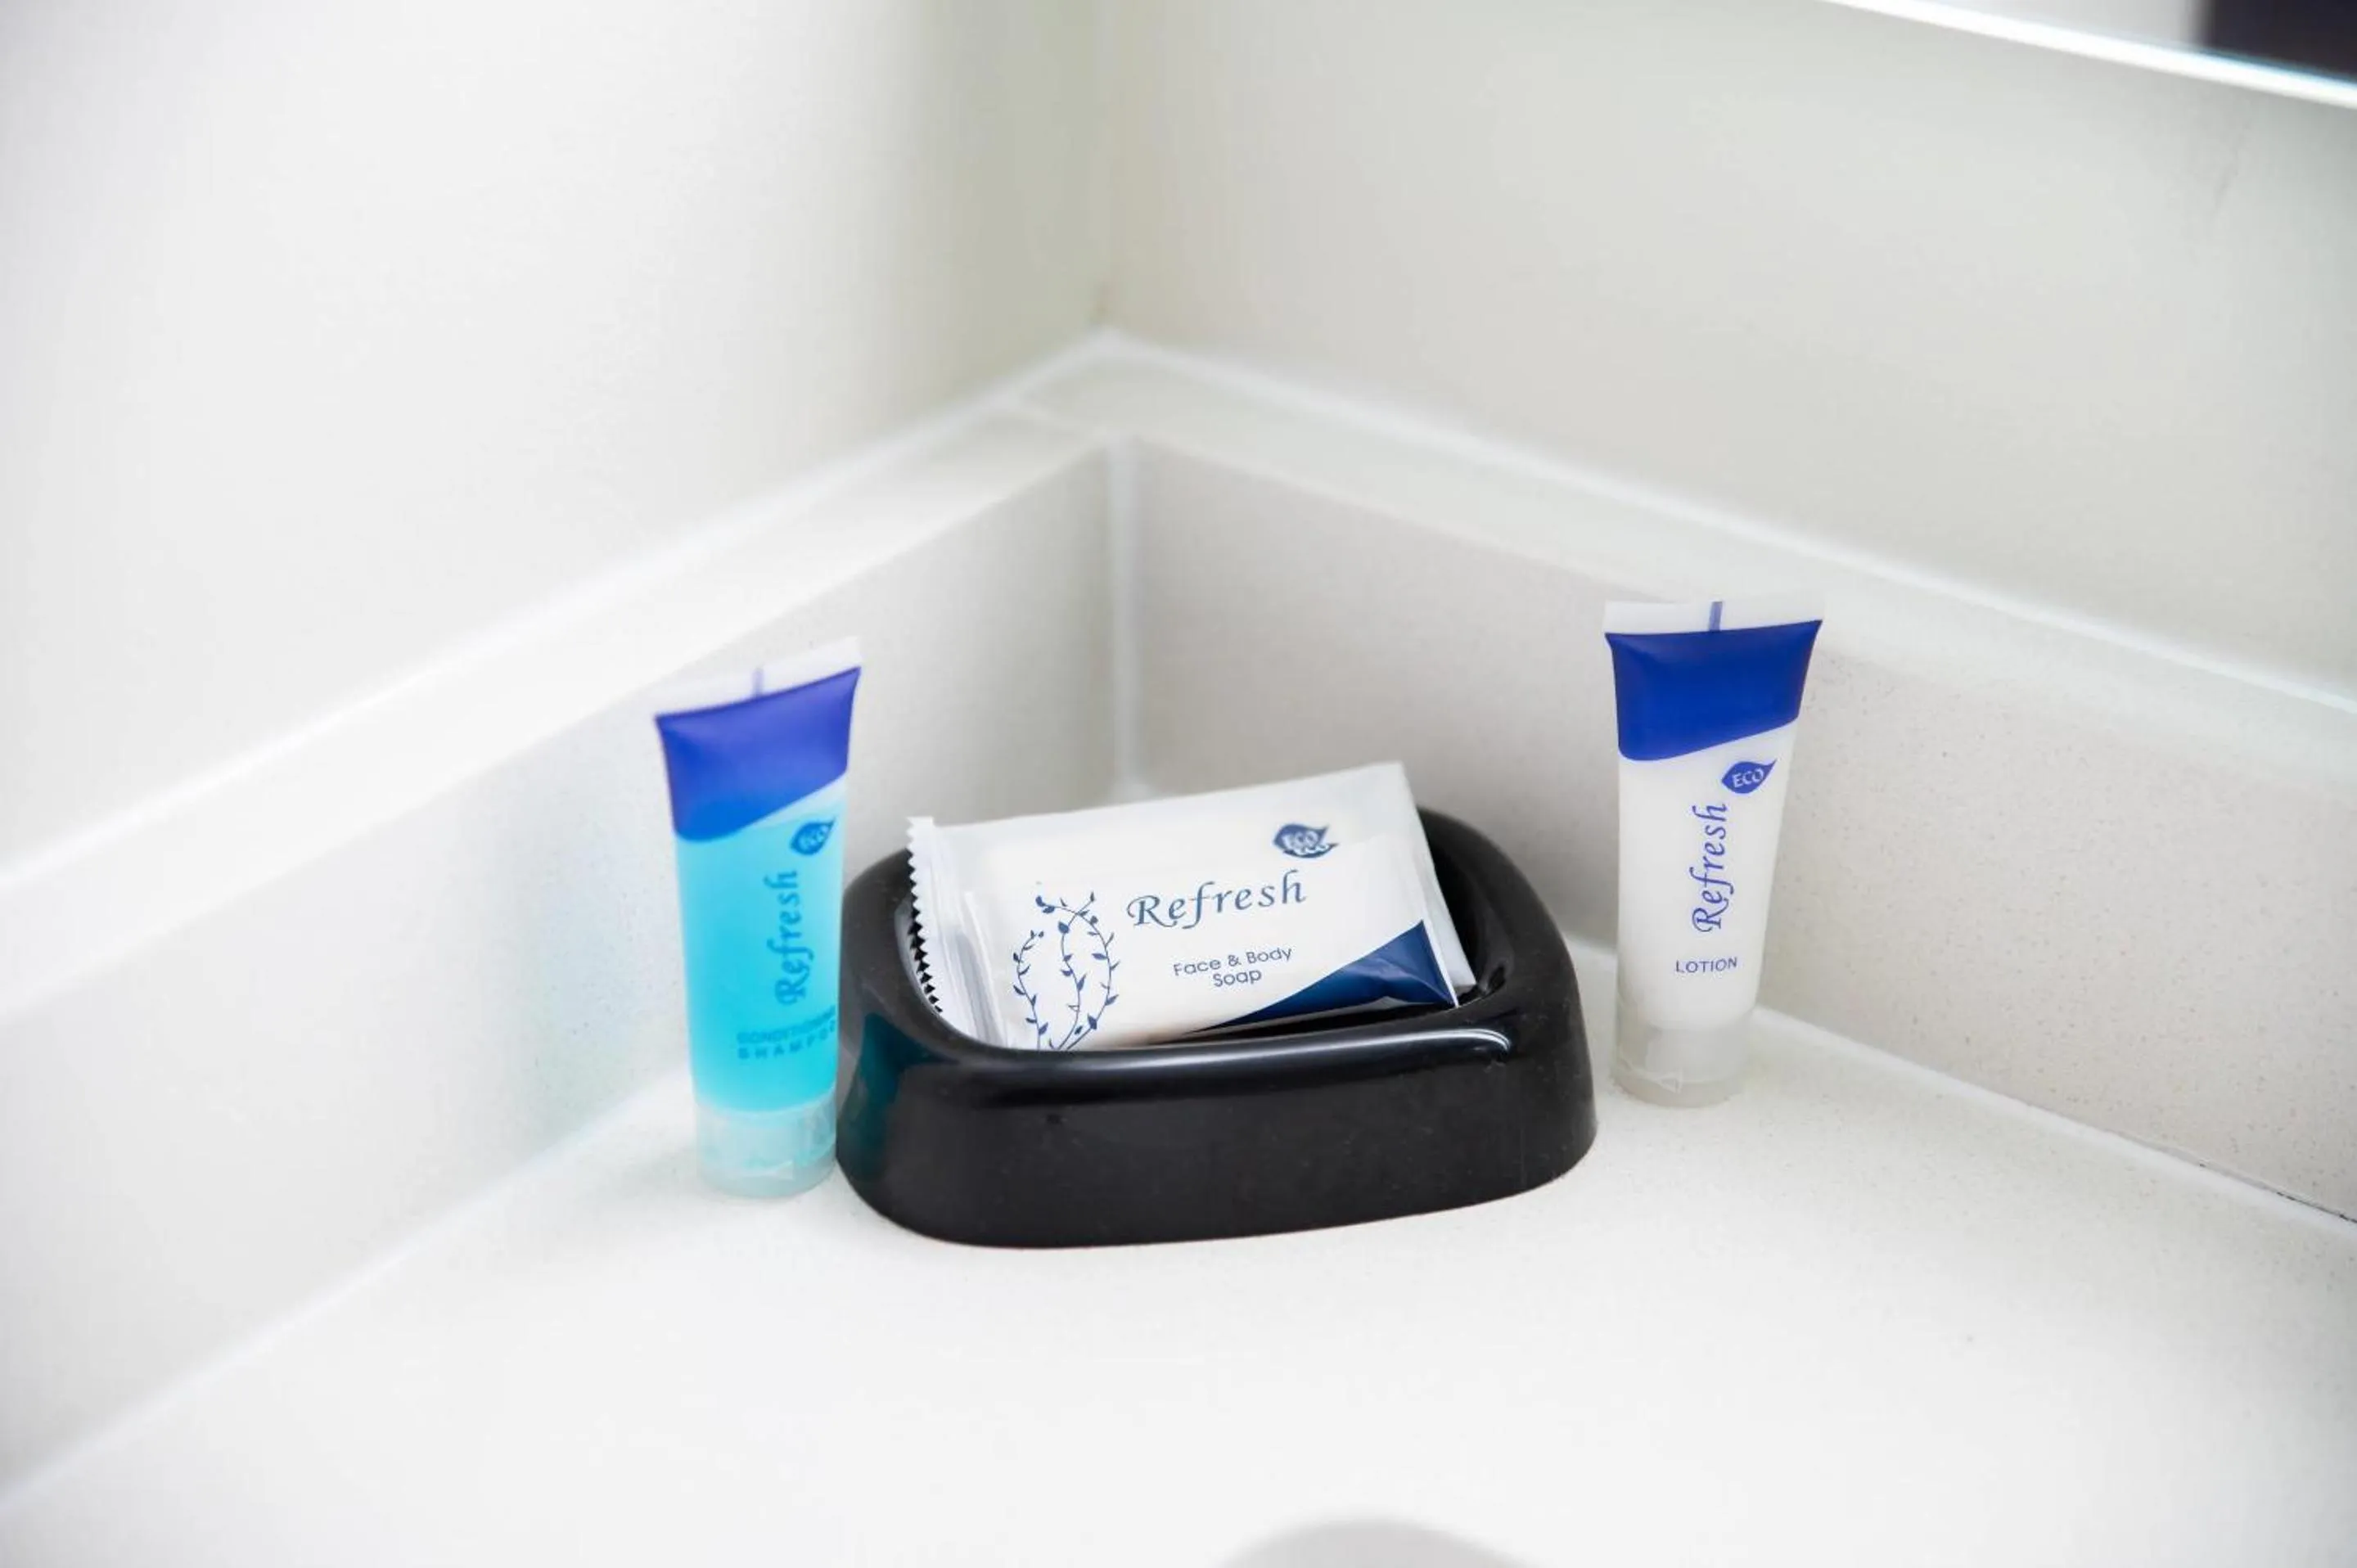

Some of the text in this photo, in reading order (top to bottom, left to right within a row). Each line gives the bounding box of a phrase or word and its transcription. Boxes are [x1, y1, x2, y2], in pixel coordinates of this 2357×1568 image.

[1732, 768, 1764, 788] ECO
[1689, 804, 1734, 932] Refresh
[1126, 869, 1307, 930] Refresh
[763, 870, 814, 1005] Refresh
[1173, 947, 1292, 976] Face & Body
[1675, 956, 1737, 973] LOTION
[1213, 969, 1262, 988] Soap
